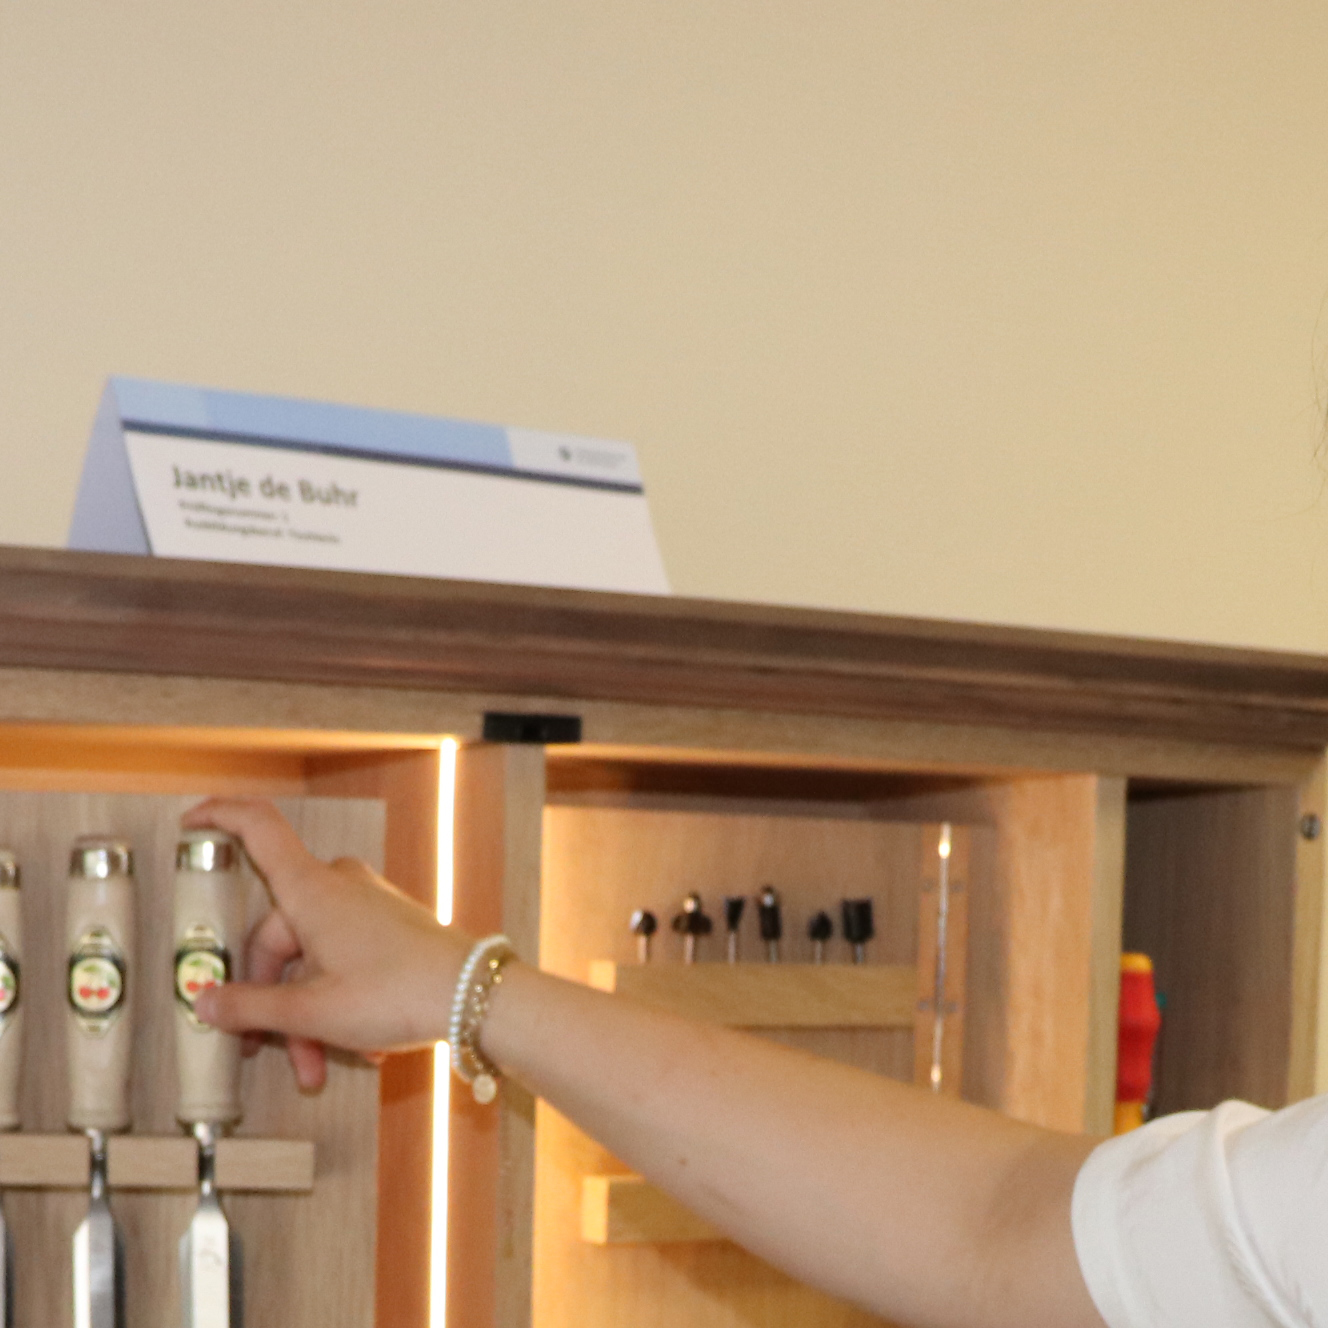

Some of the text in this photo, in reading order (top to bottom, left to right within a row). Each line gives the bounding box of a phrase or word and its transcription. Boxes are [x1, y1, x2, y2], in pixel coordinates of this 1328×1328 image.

[171, 463, 359, 507] Jantje de Buhr
